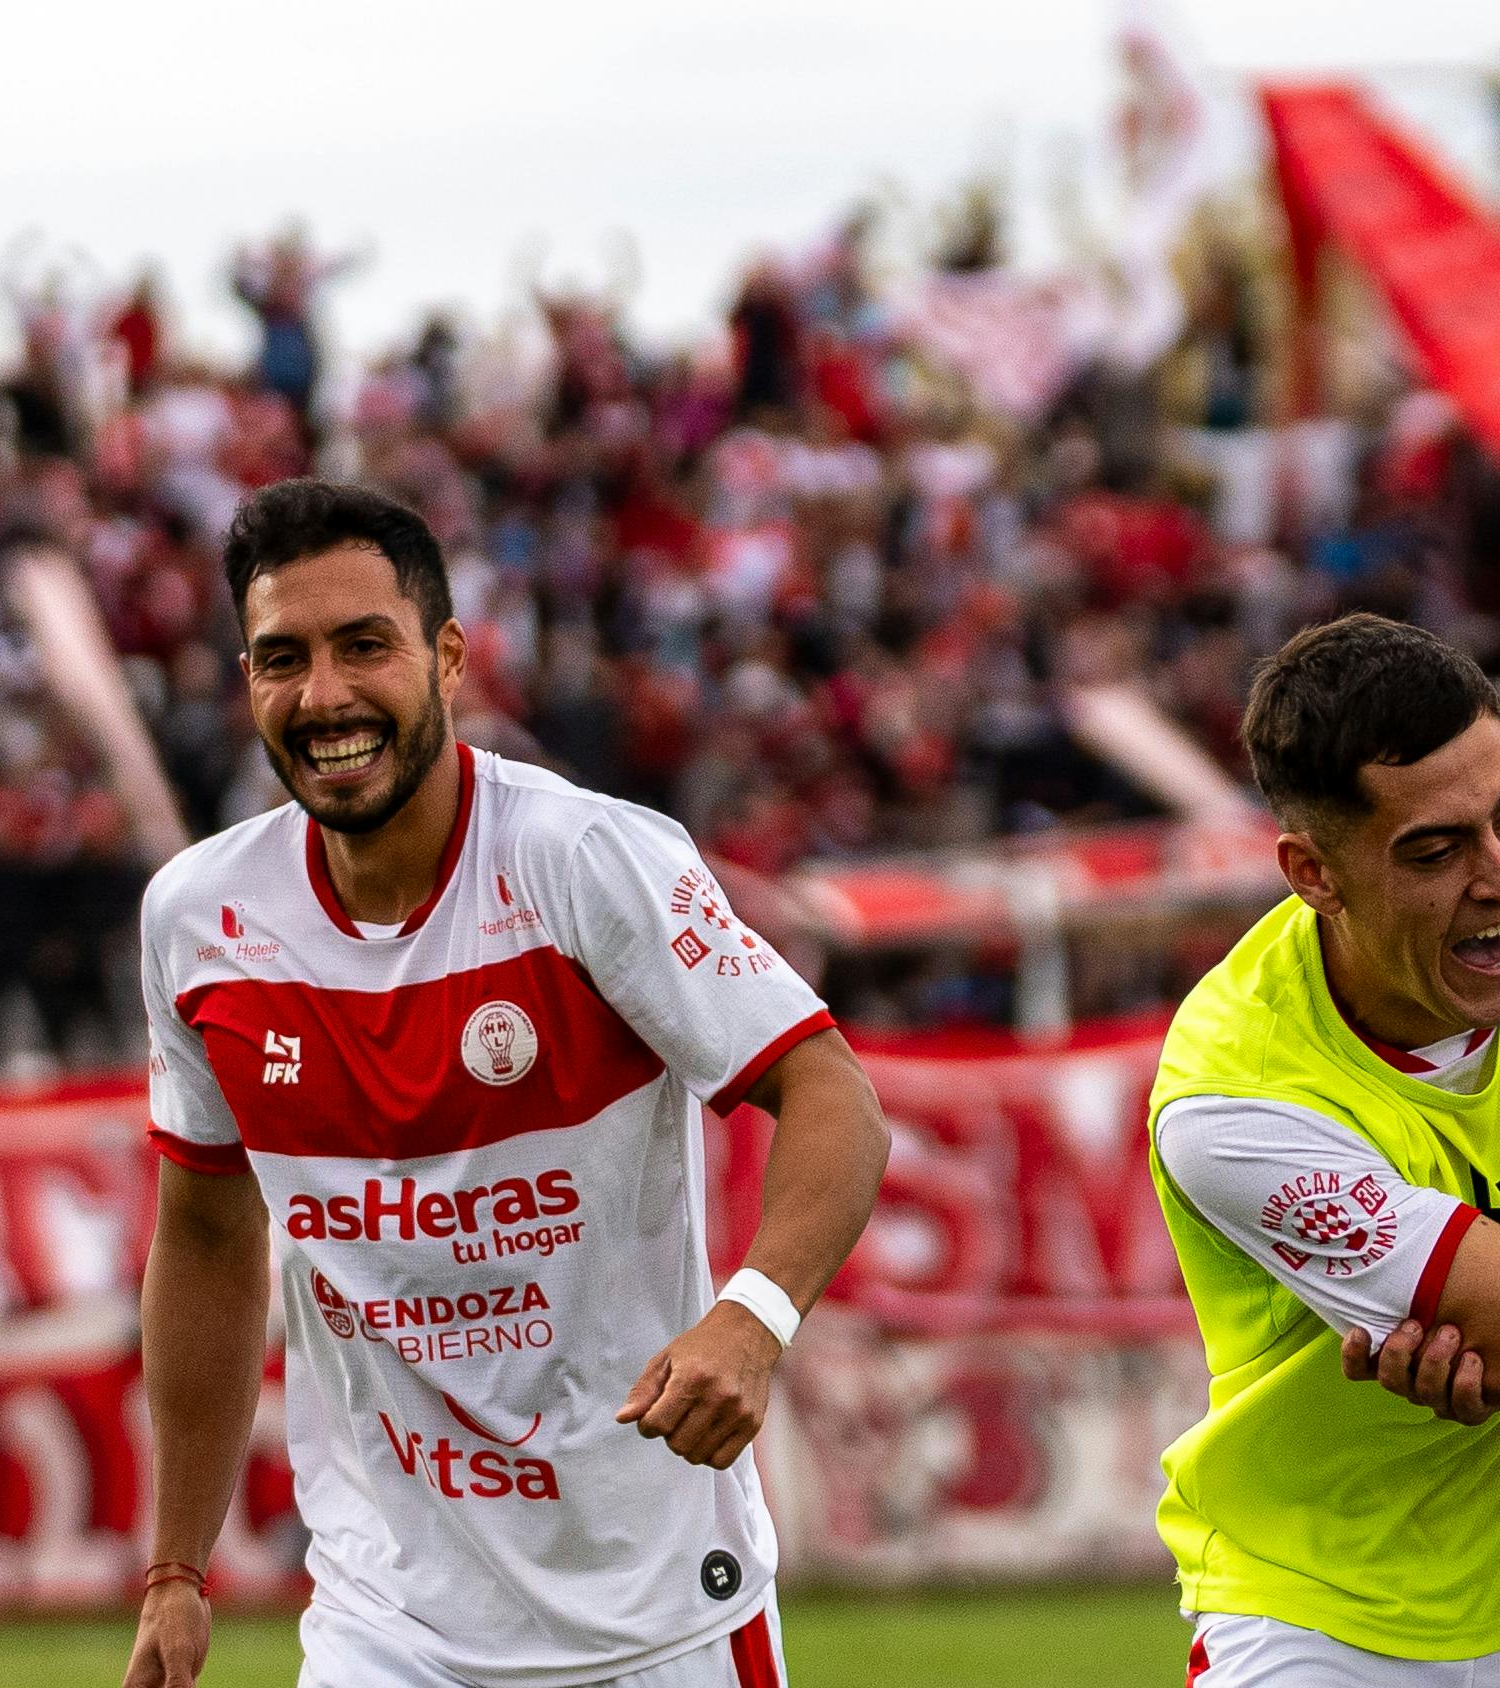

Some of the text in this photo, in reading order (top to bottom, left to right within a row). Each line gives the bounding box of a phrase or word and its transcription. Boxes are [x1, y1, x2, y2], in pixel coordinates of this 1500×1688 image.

[236, 941, 281, 957] Hotels
[674, 934, 703, 965] 19
[716, 954, 741, 977] ES
[262, 1061, 301, 1085] IFK
[286, 1168, 581, 1241] asHeras
[1260, 1172, 1341, 1232] HURACAN
[1355, 1178, 1385, 1212] 39
[452, 1221, 586, 1265] tu hogar
[1325, 1256, 1353, 1276] ES
[352, 1281, 551, 1330] ENDOZA
[360, 1318, 554, 1364] BIERNO
